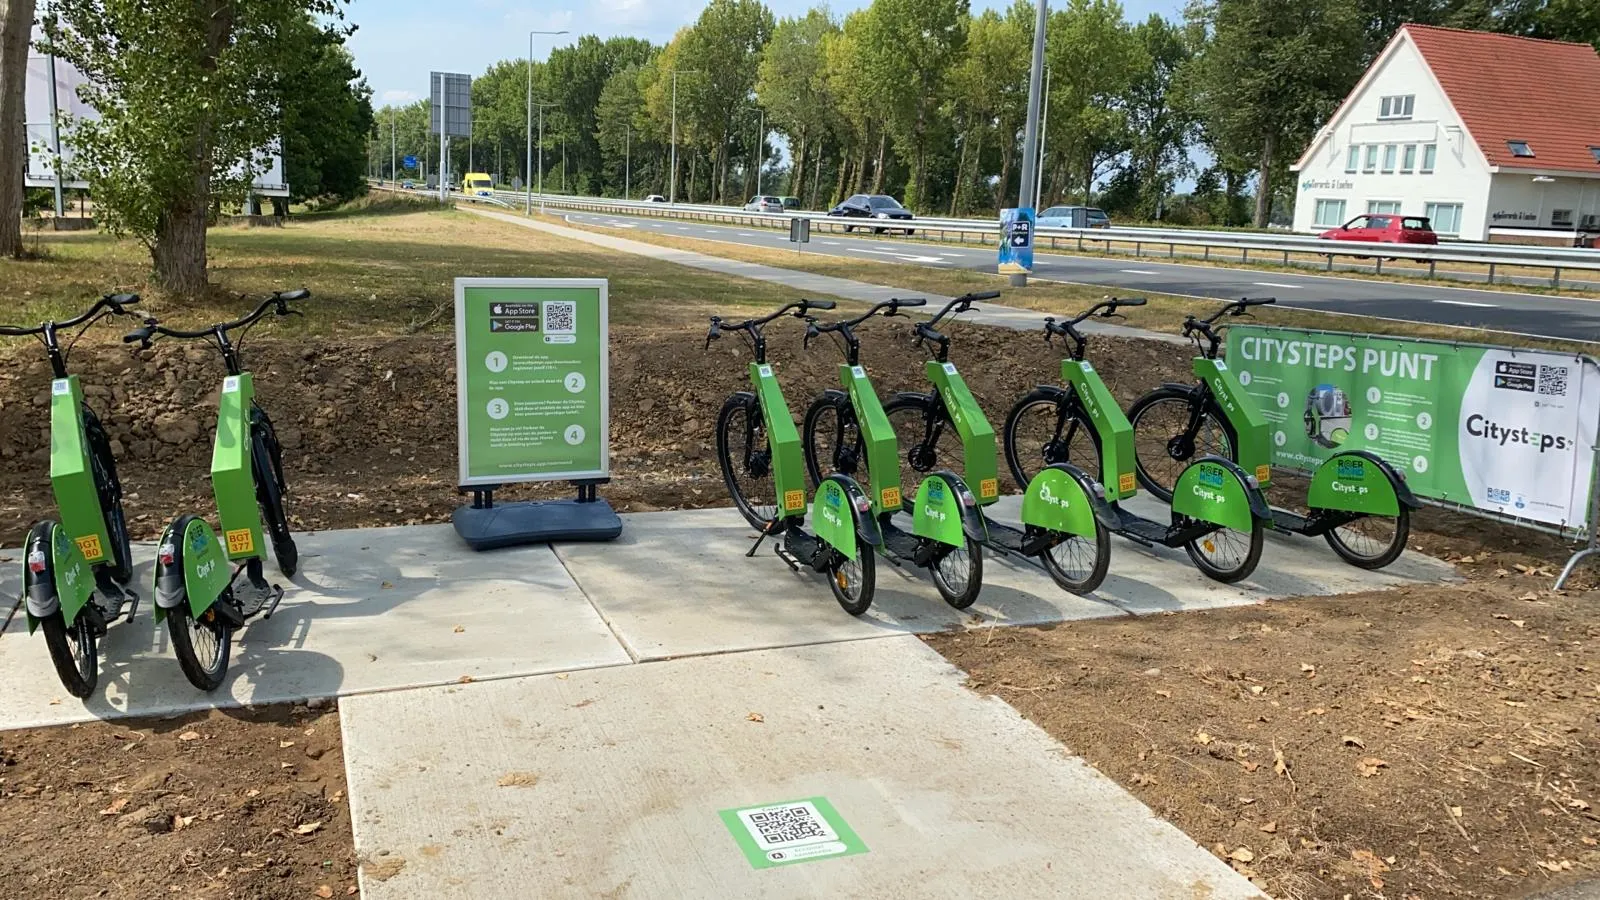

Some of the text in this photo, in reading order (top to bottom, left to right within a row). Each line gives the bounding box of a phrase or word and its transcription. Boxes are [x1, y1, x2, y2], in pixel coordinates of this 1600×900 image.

[1012, 223, 1028, 231] P+R
[504, 323, 525, 331] Google
[493, 357, 498, 367] 1
[1240, 337, 1439, 381] CITYSTEPS PUNT
[571, 378, 579, 388] 2
[1081, 382, 1100, 418] Citystps
[1214, 378, 1235, 412] Citystps
[494, 404, 501, 414] 3
[945, 386, 962, 424] Citystps
[1421, 416, 1427, 425] 2
[570, 430, 578, 440] 4
[1276, 450, 1324, 466] www.citysteps
[1338, 459, 1363, 469] ROER
[1417, 460, 1423, 468] 4
[1200, 464, 1224, 478] ROER
[786, 493, 803, 502] BGT
[883, 490, 899, 499] BGT
[1040, 486, 1069, 509] Citystps
[924, 505, 946, 521] Citystps
[229, 532, 250, 543] BGT
[231, 541, 250, 551] 377
[84, 548, 99, 558] 80
